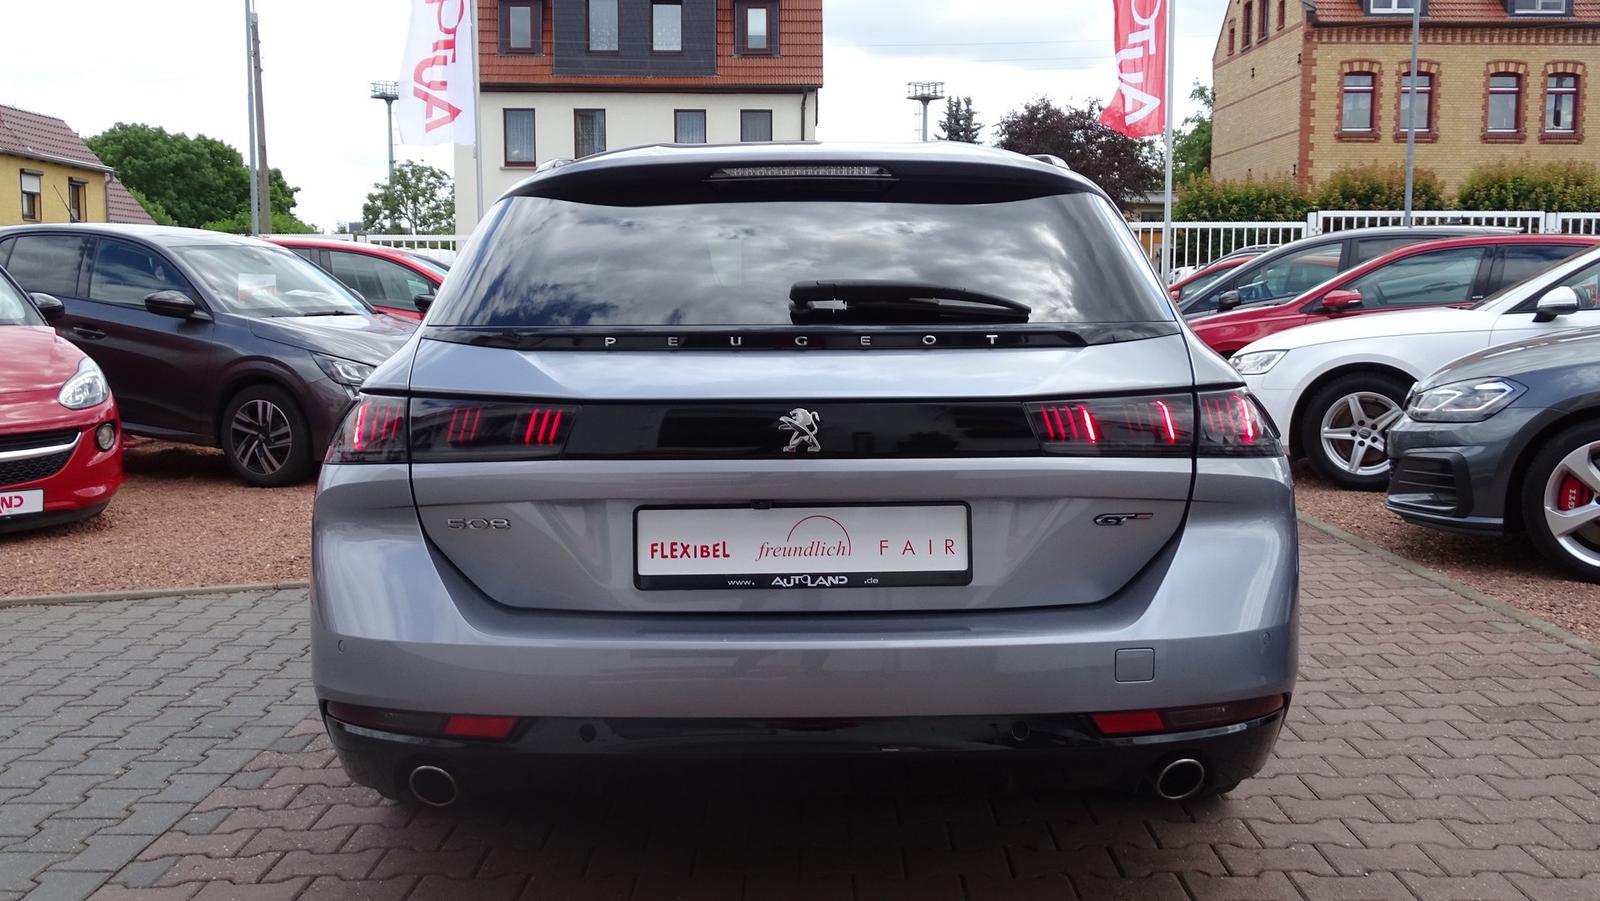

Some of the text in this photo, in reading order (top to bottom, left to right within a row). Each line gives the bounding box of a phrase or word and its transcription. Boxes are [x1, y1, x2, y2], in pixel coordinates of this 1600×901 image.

[604, 334, 999, 347] PEUGEOT
[447, 518, 512, 530] 508
[650, 538, 956, 562] FLEXIBEL freundlich FAIR
[771, 574, 849, 587] AUTOLAND
